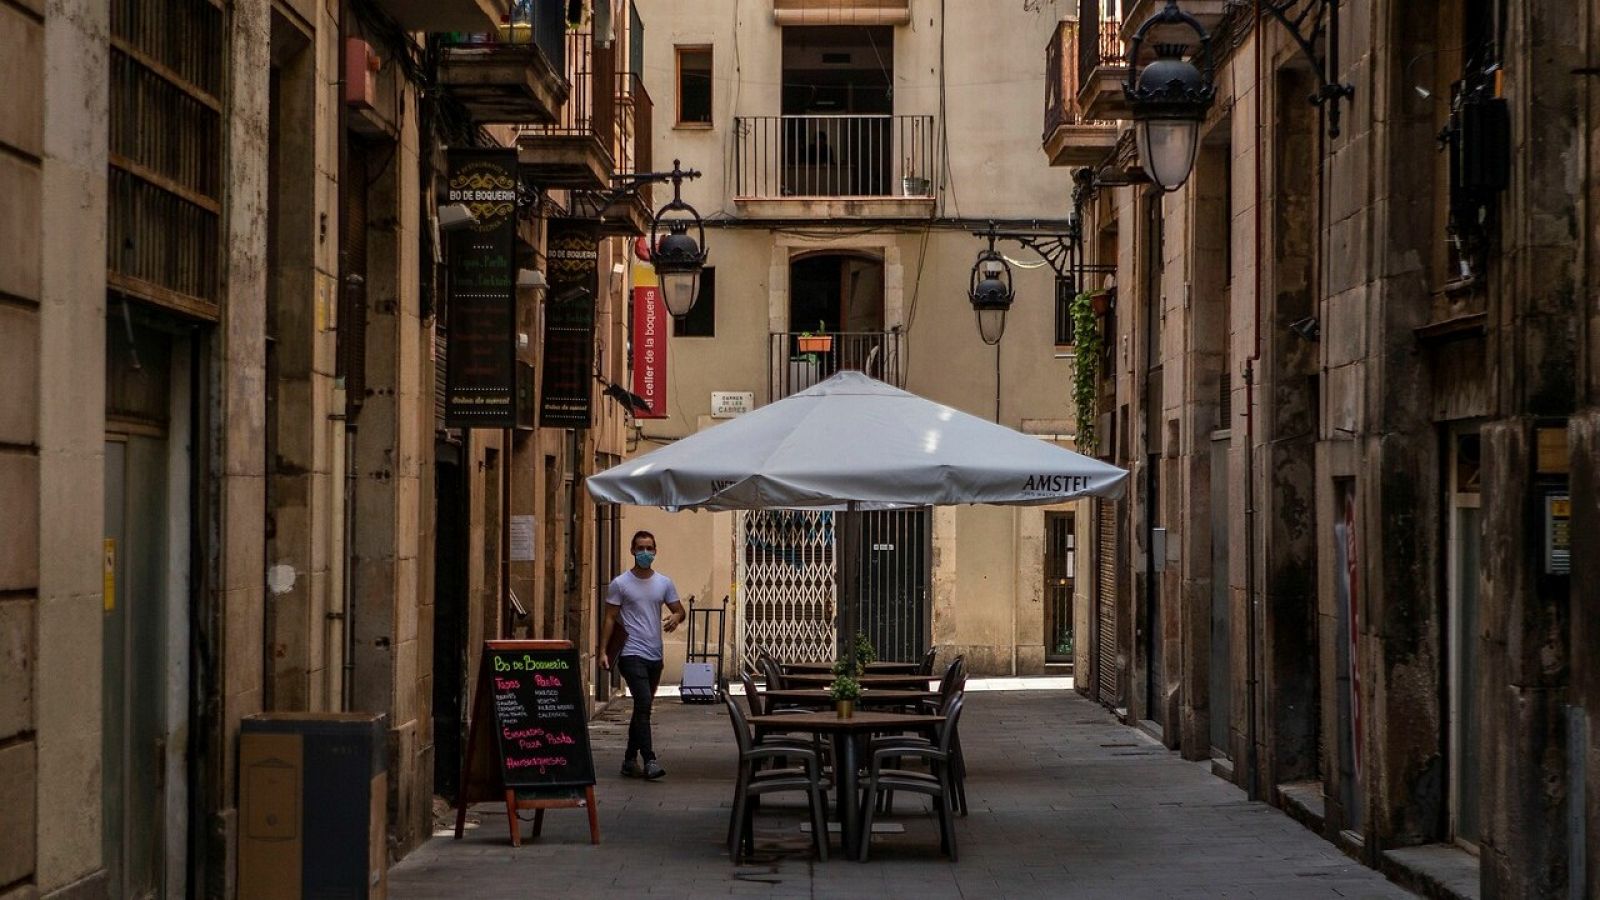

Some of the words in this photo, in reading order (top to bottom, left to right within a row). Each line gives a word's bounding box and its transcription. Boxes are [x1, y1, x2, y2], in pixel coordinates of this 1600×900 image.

[449, 190, 462, 201] BO
[463, 190, 474, 201] DE
[475, 190, 516, 201] BOQUERIA
[557, 249, 566, 259] DE
[566, 250, 597, 260] BOQUERIA
[645, 338, 655, 348] la
[645, 349, 655, 364] de
[645, 365, 655, 396] celler
